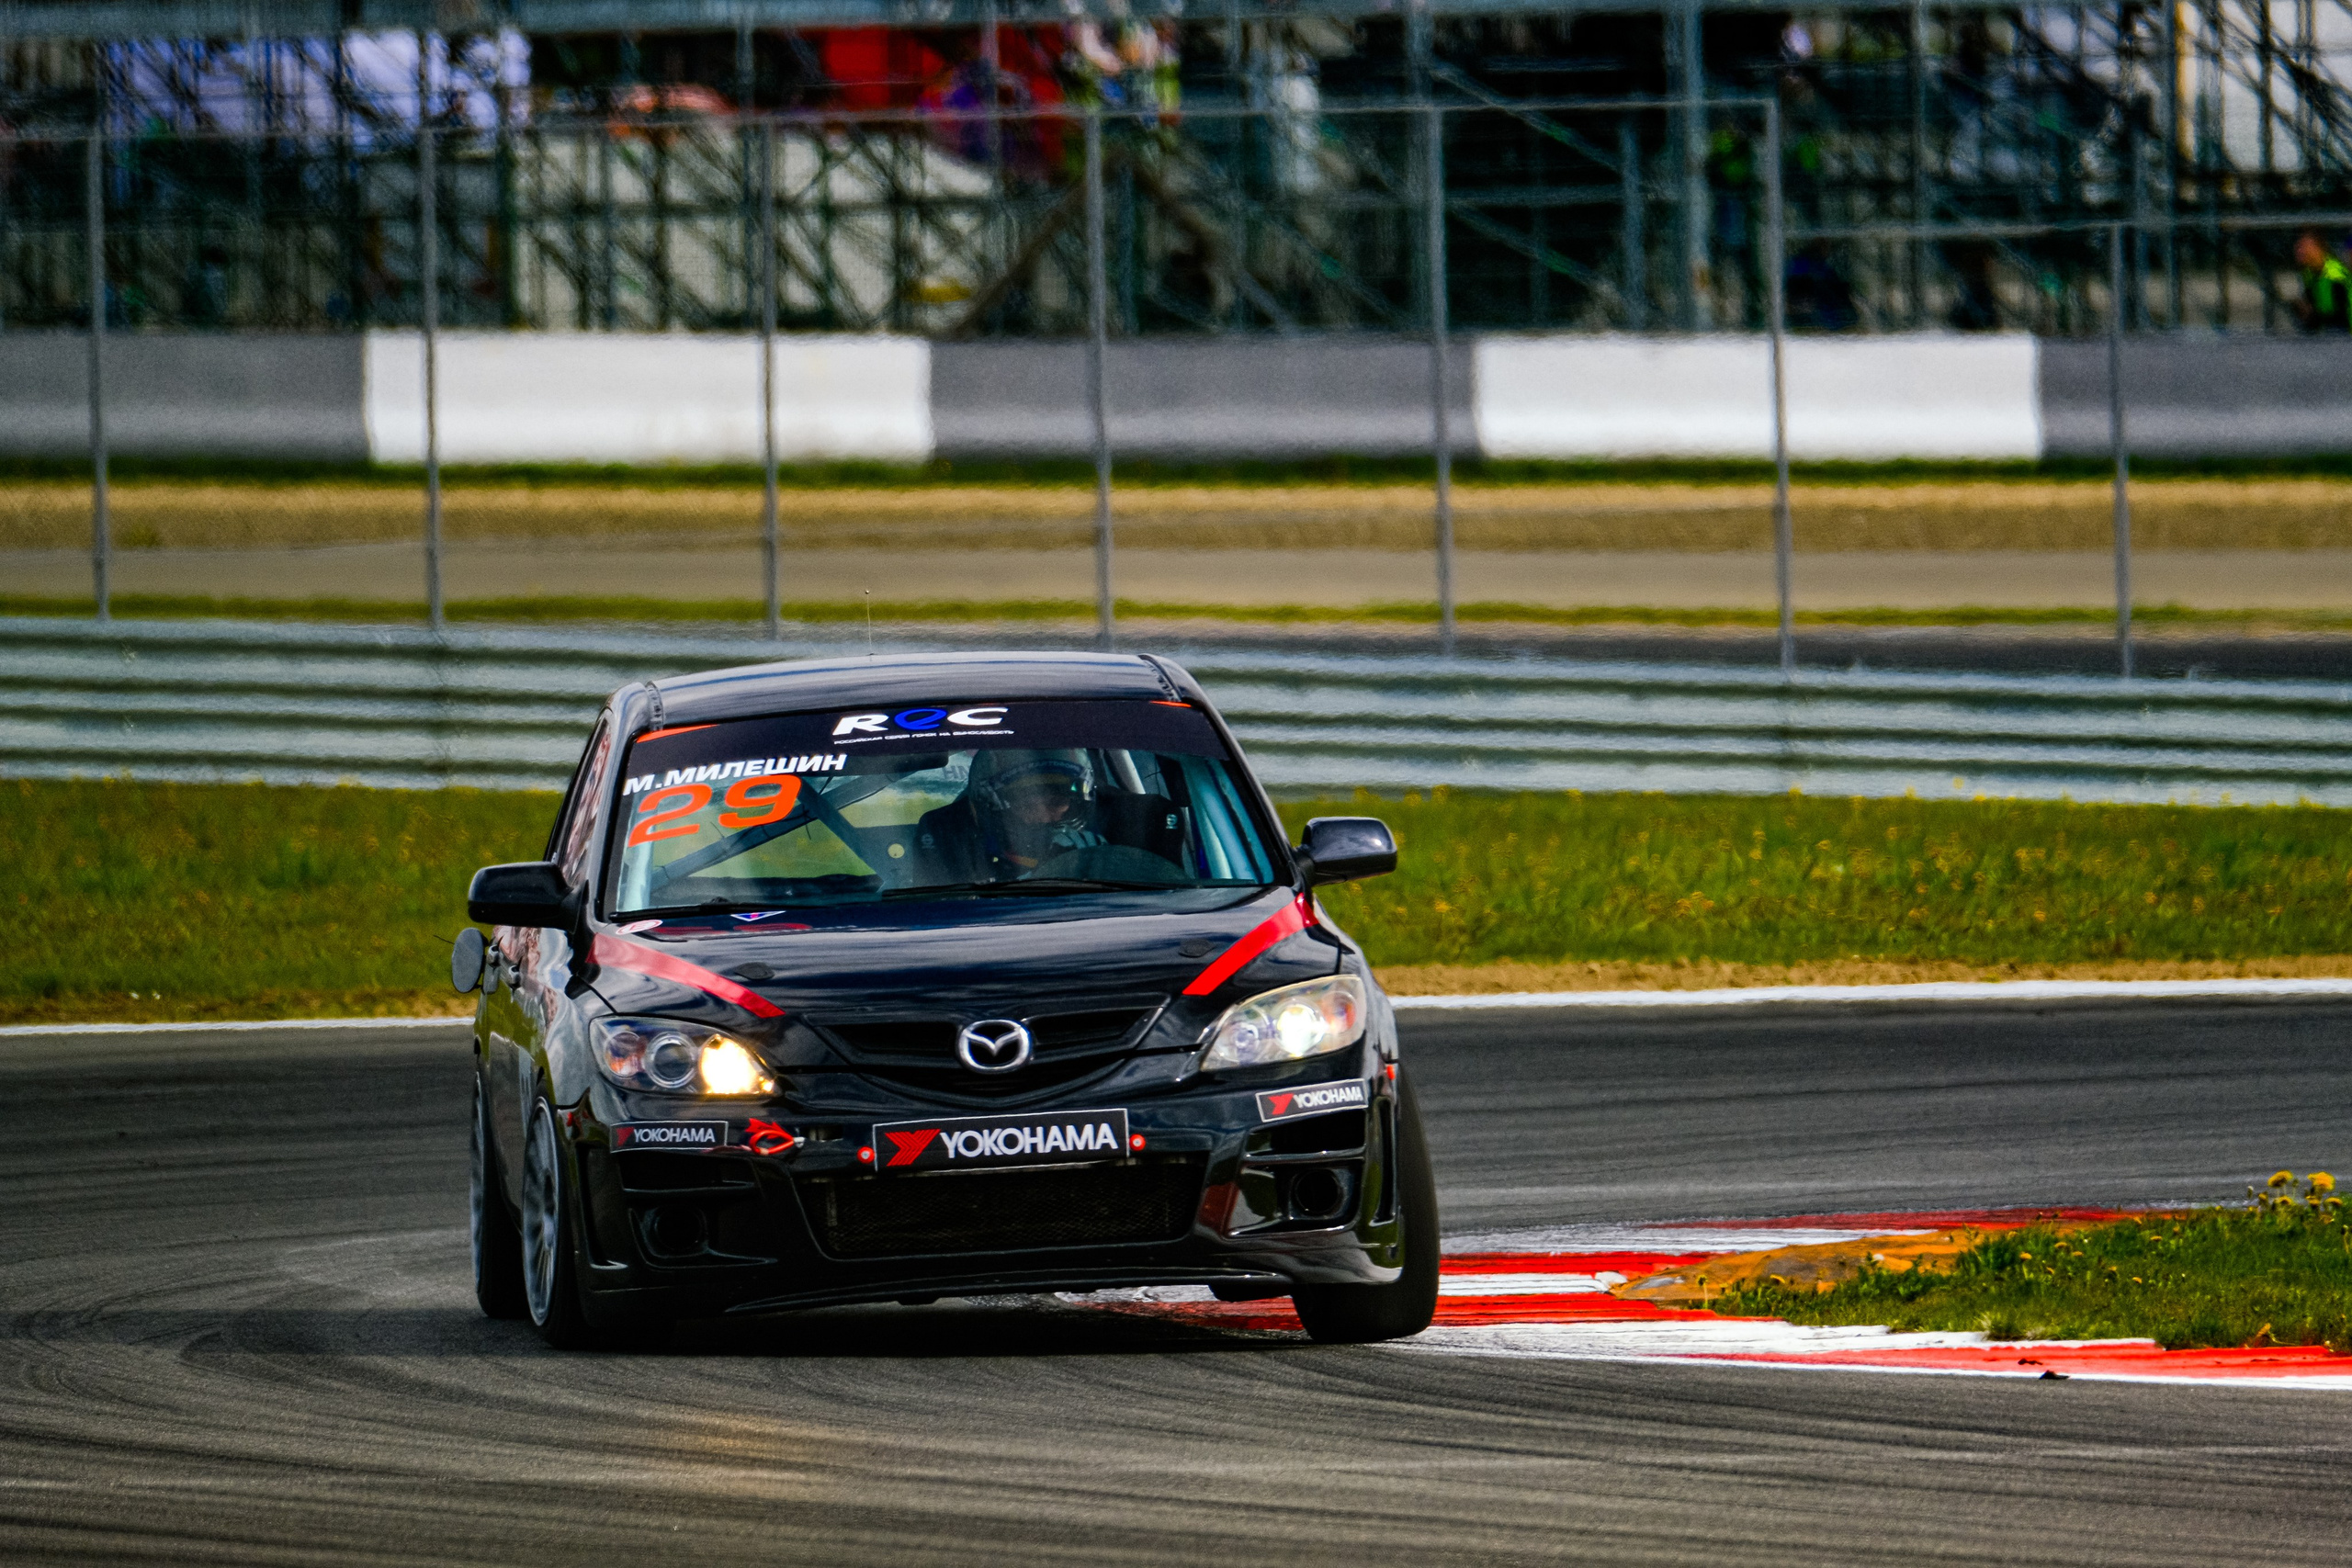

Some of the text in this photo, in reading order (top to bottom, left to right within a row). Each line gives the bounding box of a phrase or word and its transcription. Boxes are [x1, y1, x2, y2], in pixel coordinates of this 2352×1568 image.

[623, 753, 847, 796] М.МИЛЕШИН
[628, 773, 802, 848] 29
[1292, 1086, 1363, 1109] YOKOHAMA
[633, 1127, 716, 1144] YOKOHAMA
[939, 1122, 1118, 1159] YOKOHAMA
